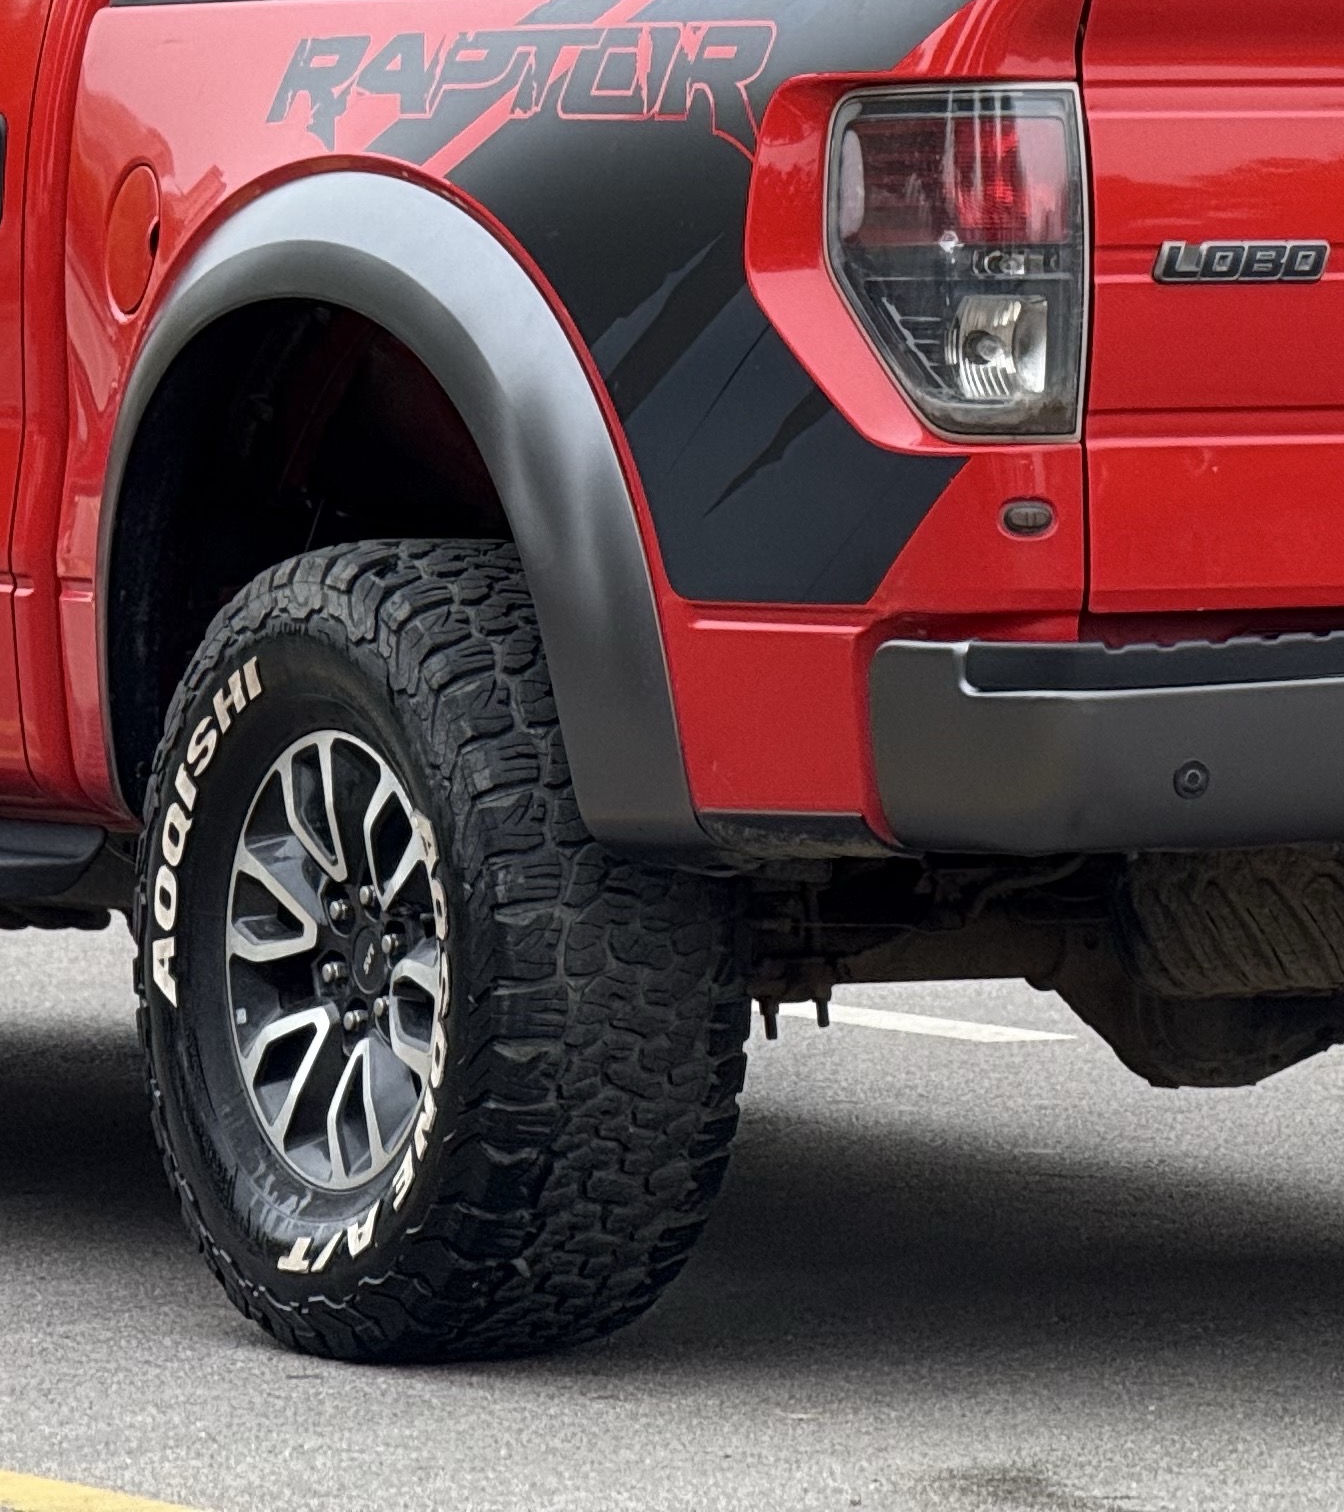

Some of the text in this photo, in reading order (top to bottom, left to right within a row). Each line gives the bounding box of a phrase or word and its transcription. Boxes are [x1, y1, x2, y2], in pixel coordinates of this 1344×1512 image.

[264, 19, 778, 156] RAPTOR
[1154, 239, 1331, 283] LOBO
[152, 656, 265, 1009] AOQISHI
[276, 1198, 381, 1273] A/T
